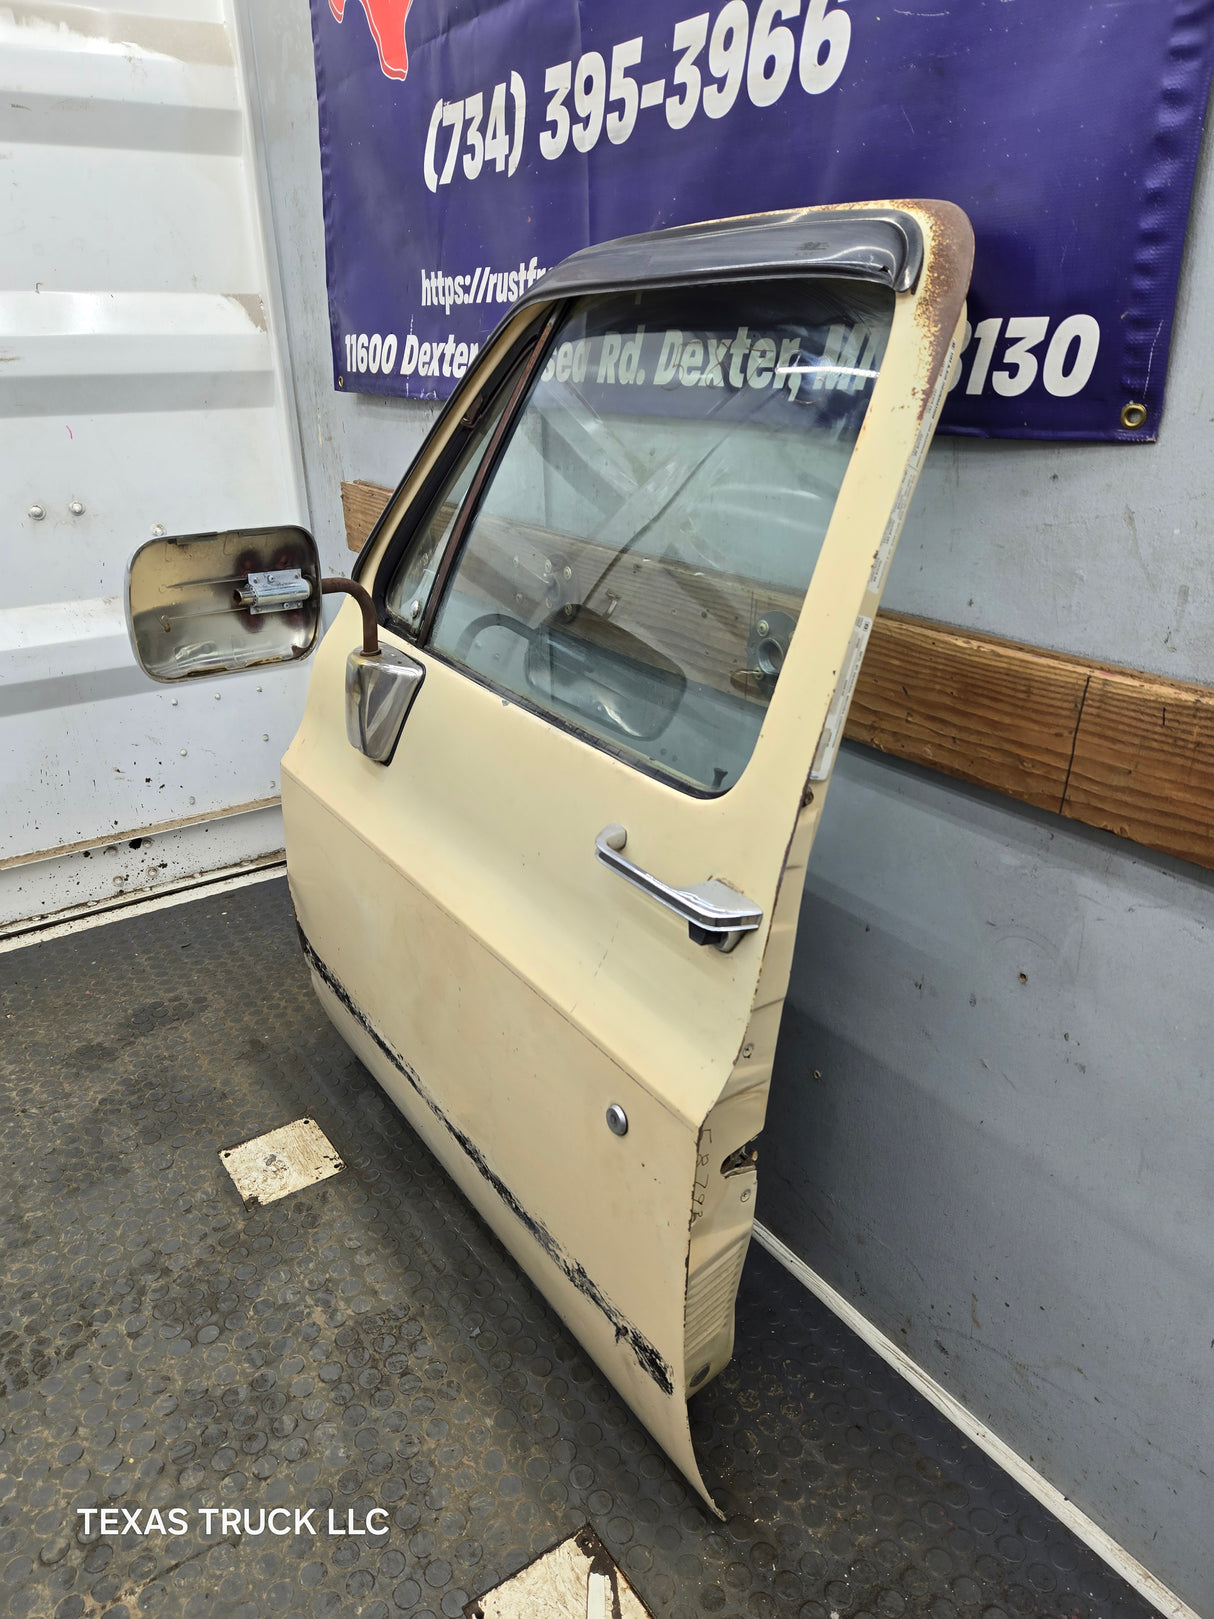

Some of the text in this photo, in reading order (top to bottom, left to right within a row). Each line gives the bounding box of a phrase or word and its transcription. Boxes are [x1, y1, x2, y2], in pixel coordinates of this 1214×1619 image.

[423, 0, 852, 193] (734) 395-3966
[345, 333, 398, 374] 11600
[596, 325, 646, 386] Rd.
[652, 326, 801, 402] Dexter,
[948, 313, 1100, 398] 130
